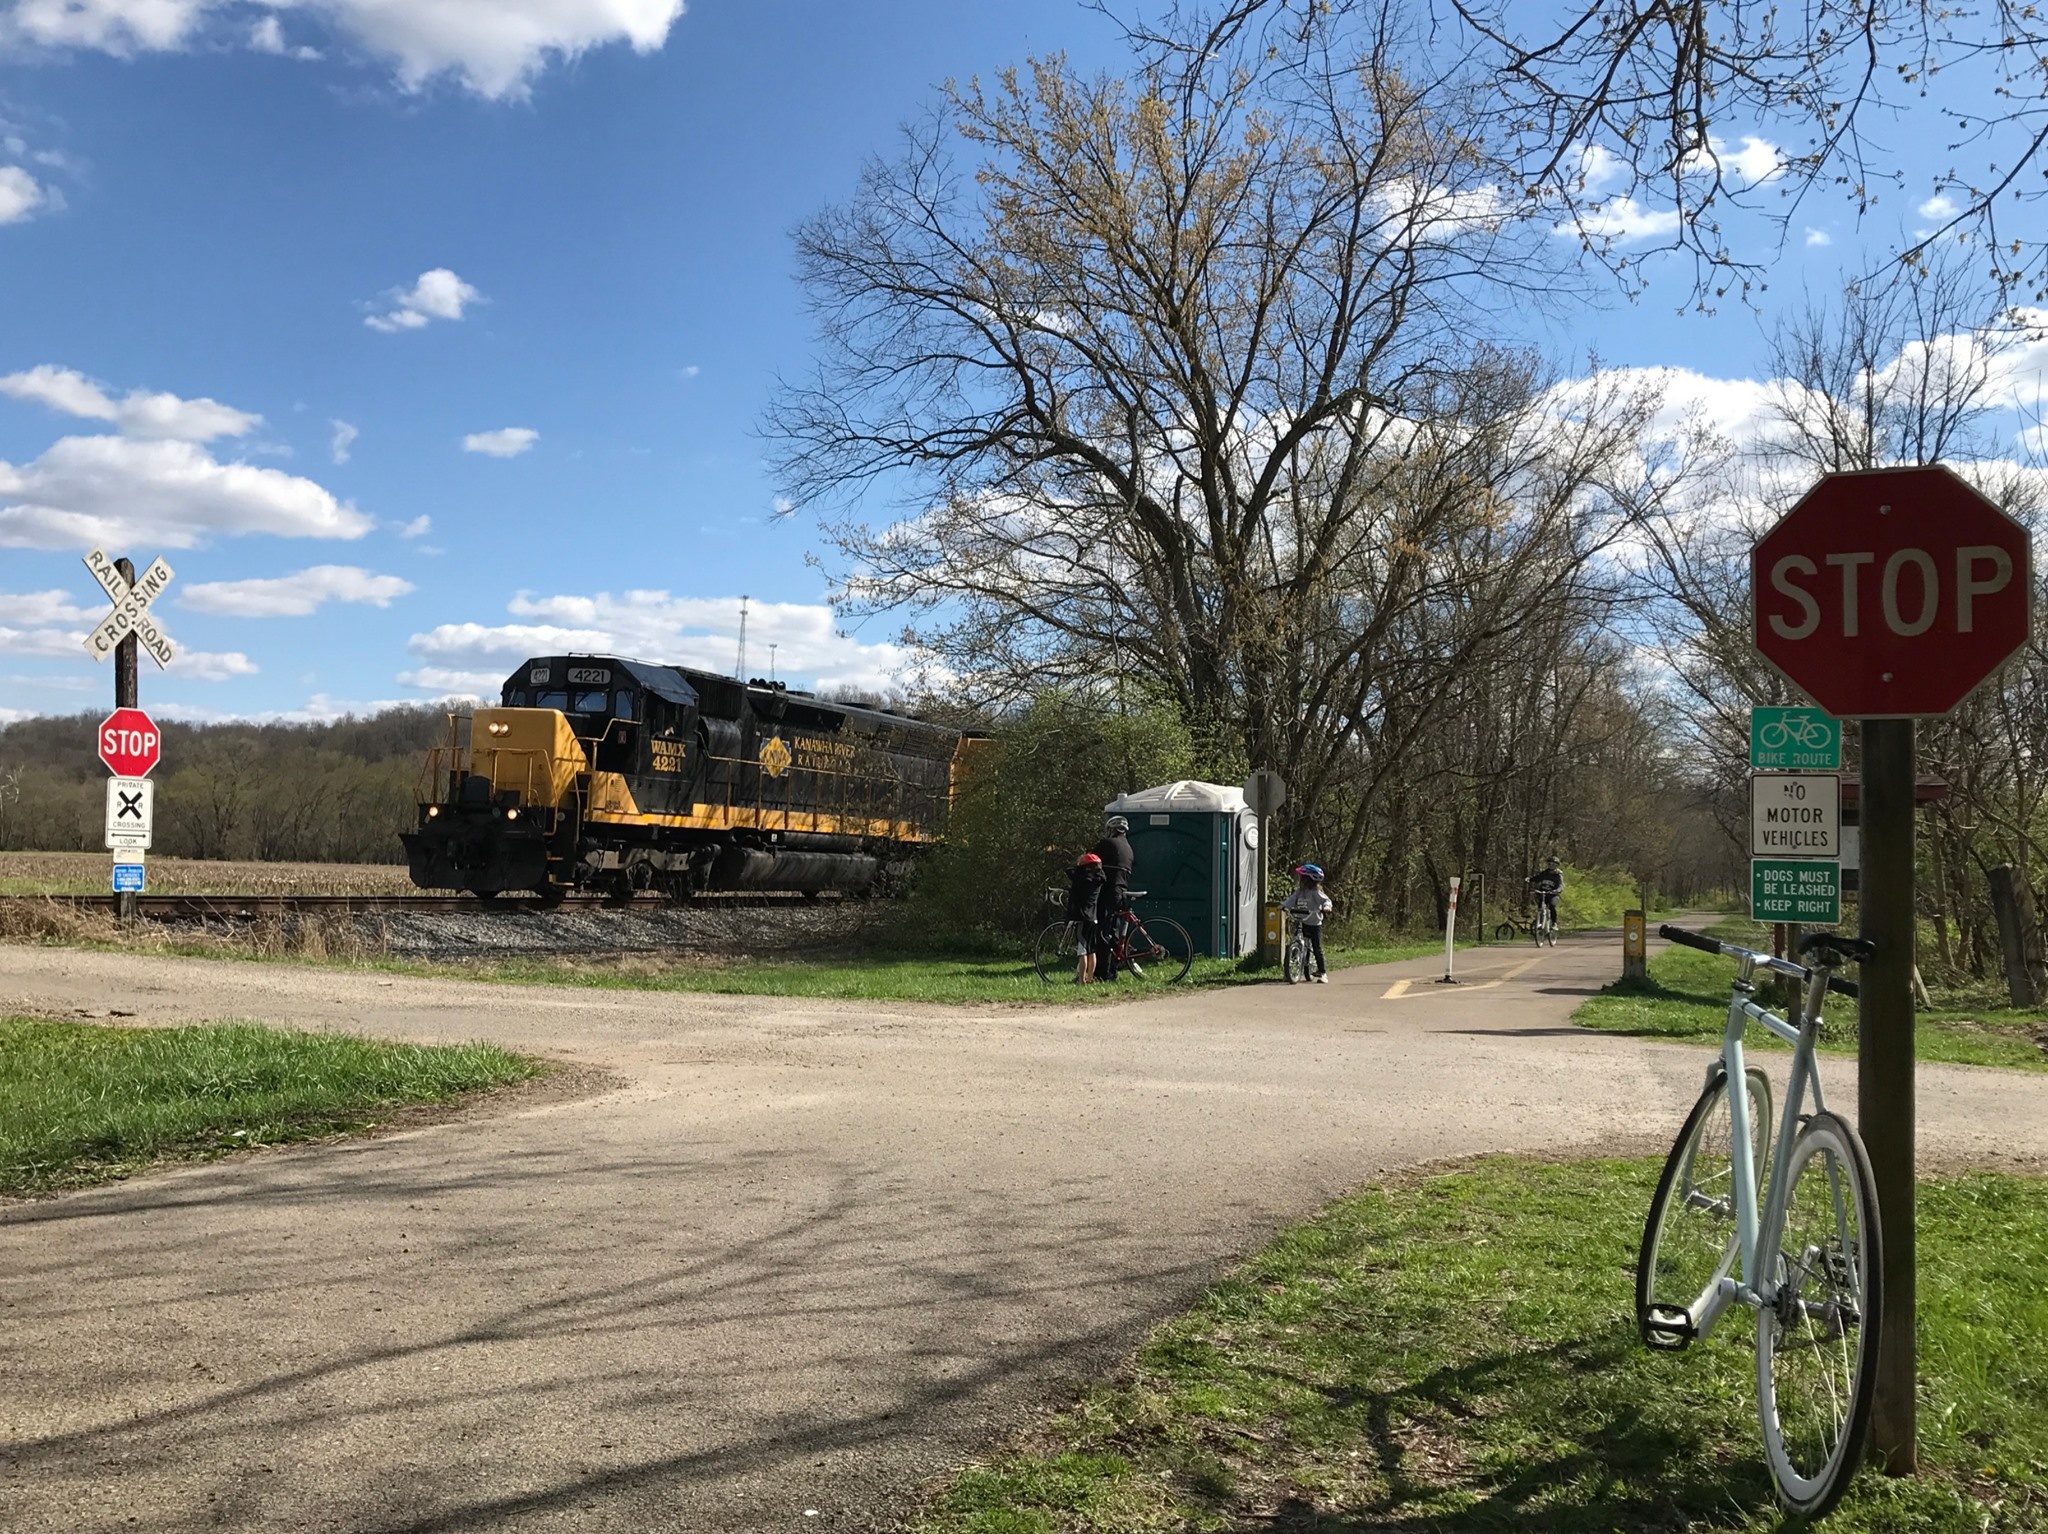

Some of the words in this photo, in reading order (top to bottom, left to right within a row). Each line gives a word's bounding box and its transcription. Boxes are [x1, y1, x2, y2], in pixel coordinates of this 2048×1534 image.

[1768, 545, 2013, 640] STOP
[89, 550, 122, 597] RAIL
[136, 616, 172, 663] ROAD
[95, 566, 167, 652] CROSSING
[534, 669, 548, 681] 4221
[574, 670, 605, 682] 4221
[103, 728, 157, 757] STOP
[650, 739, 686, 758] WAMX
[794, 736, 833, 755] KANAWHA
[652, 755, 682, 773] 4221
[1758, 752, 1786, 764] BIKE
[1792, 753, 1832, 765] ROUTE
[117, 781, 144, 789] PRIVATE
[1784, 784, 1806, 800] NO
[1767, 807, 1823, 823] MOTOR
[112, 821, 146, 829] CROSSING
[1763, 830, 1828, 847] VEHICLES
[1764, 870, 1794, 882] DOGS
[1799, 871, 1830, 883] MUST
[1764, 883, 1778, 895] BE
[1783, 884, 1836, 896] LEASHED
[1764, 899, 1792, 912] KEEP
[1797, 901, 1831, 913] RIGHT
